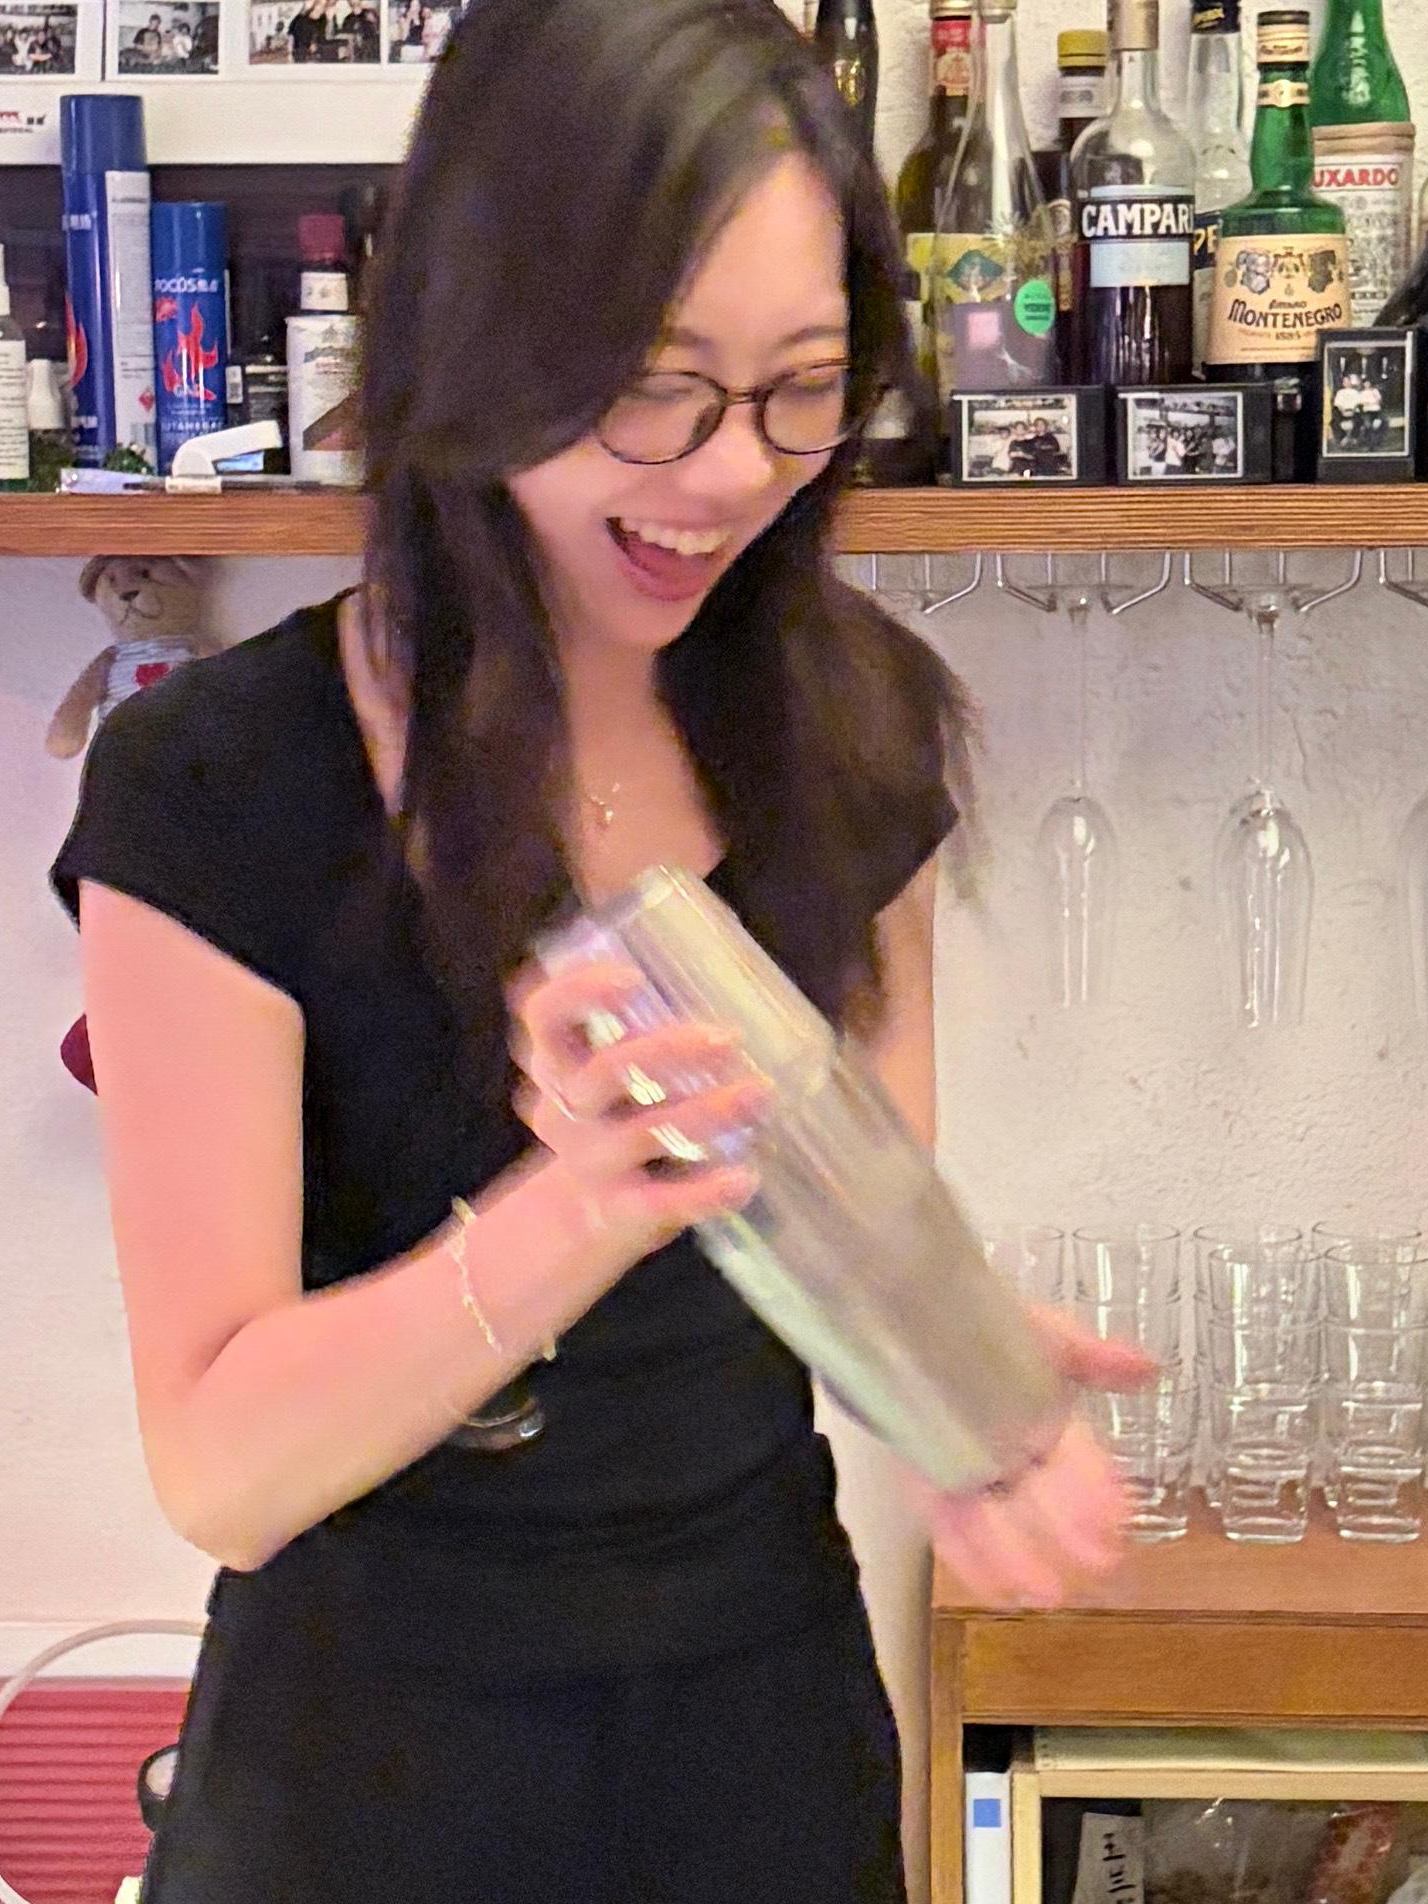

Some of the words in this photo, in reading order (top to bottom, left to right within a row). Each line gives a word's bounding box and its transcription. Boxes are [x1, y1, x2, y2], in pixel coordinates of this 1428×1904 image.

[1311, 168, 1401, 188] UXARDO
[1081, 202, 1195, 238] CAMPARI
[1227, 298, 1343, 329] MONTENEGRO
